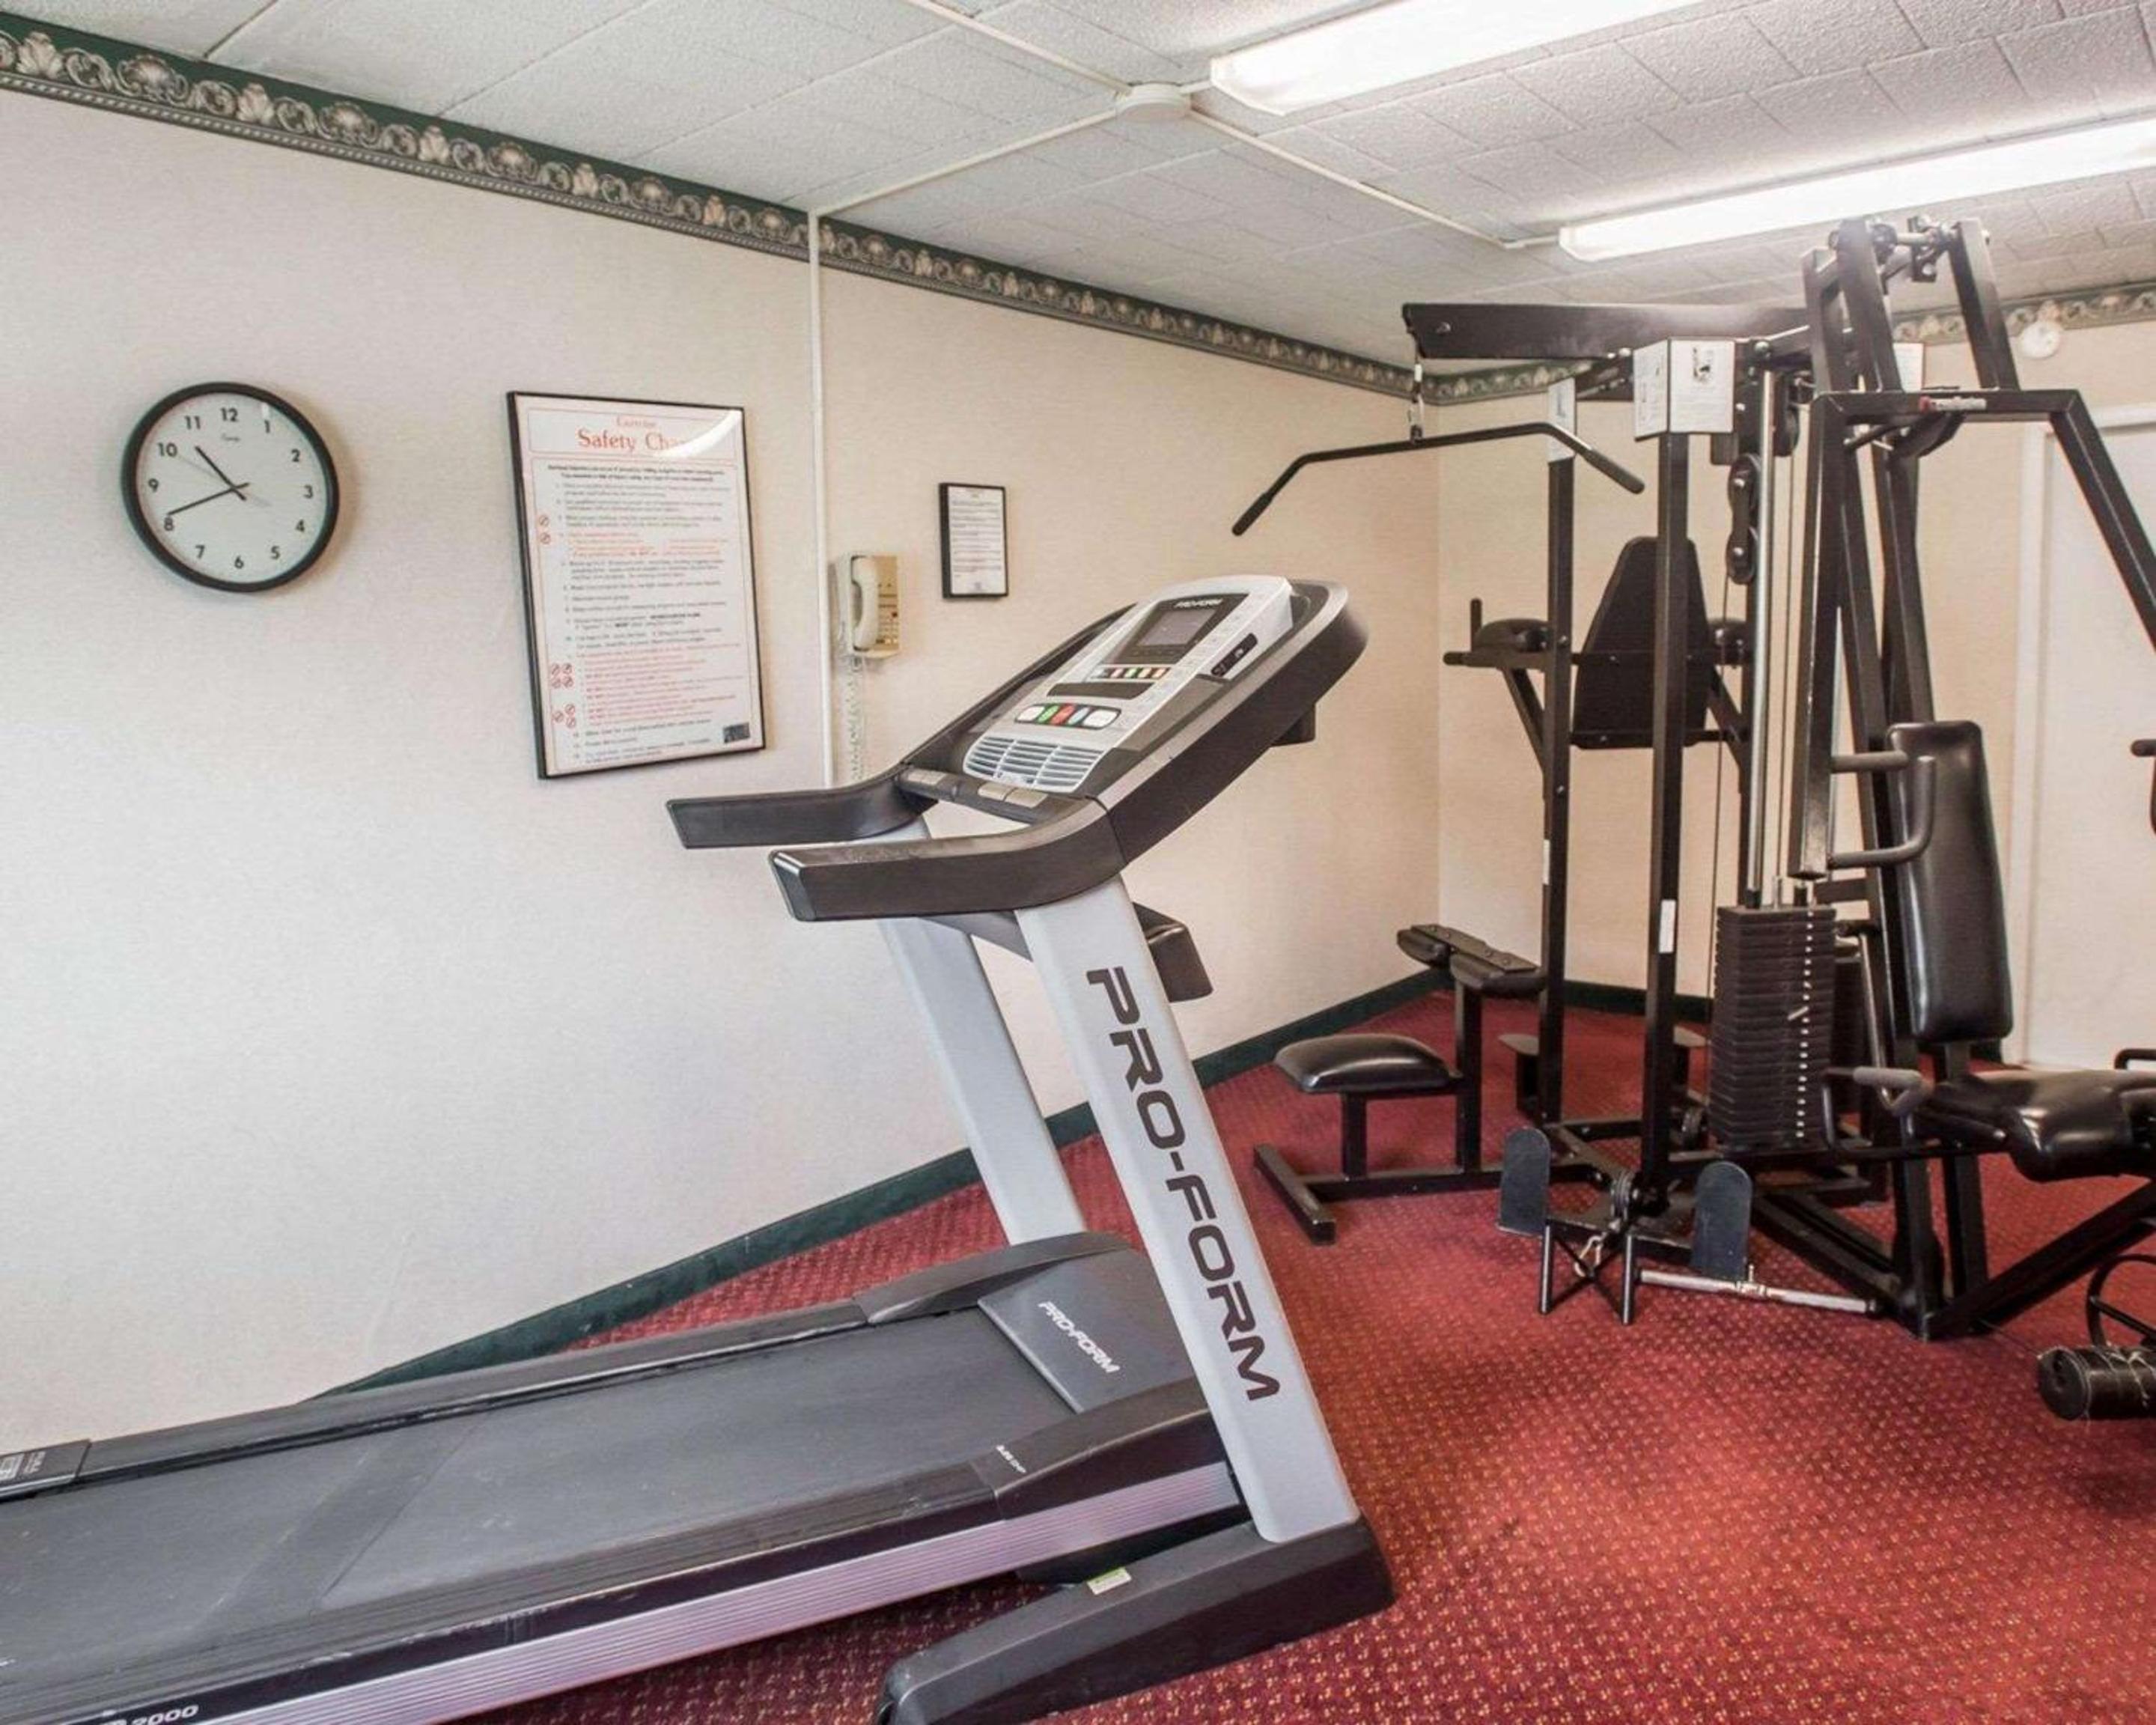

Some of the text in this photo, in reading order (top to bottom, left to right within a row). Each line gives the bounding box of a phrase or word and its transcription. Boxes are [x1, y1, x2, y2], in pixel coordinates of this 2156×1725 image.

[220, 407, 238, 422] 12
[184, 416, 201, 430] 11
[264, 420, 270, 433] 1
[578, 428, 636, 452] Safety
[157, 442, 178, 457] 10
[291, 449, 300, 463] 2
[148, 478, 159, 493] 9
[304, 485, 313, 499] 3
[163, 517, 174, 532] 8
[295, 519, 305, 532] 4
[195, 544, 205, 559] 7
[271, 546, 281, 560] 5
[234, 556, 244, 569] 6
[1086, 966, 1280, 1402] PRO-FORM
[1038, 1300, 1121, 1374] PRO-FORM
